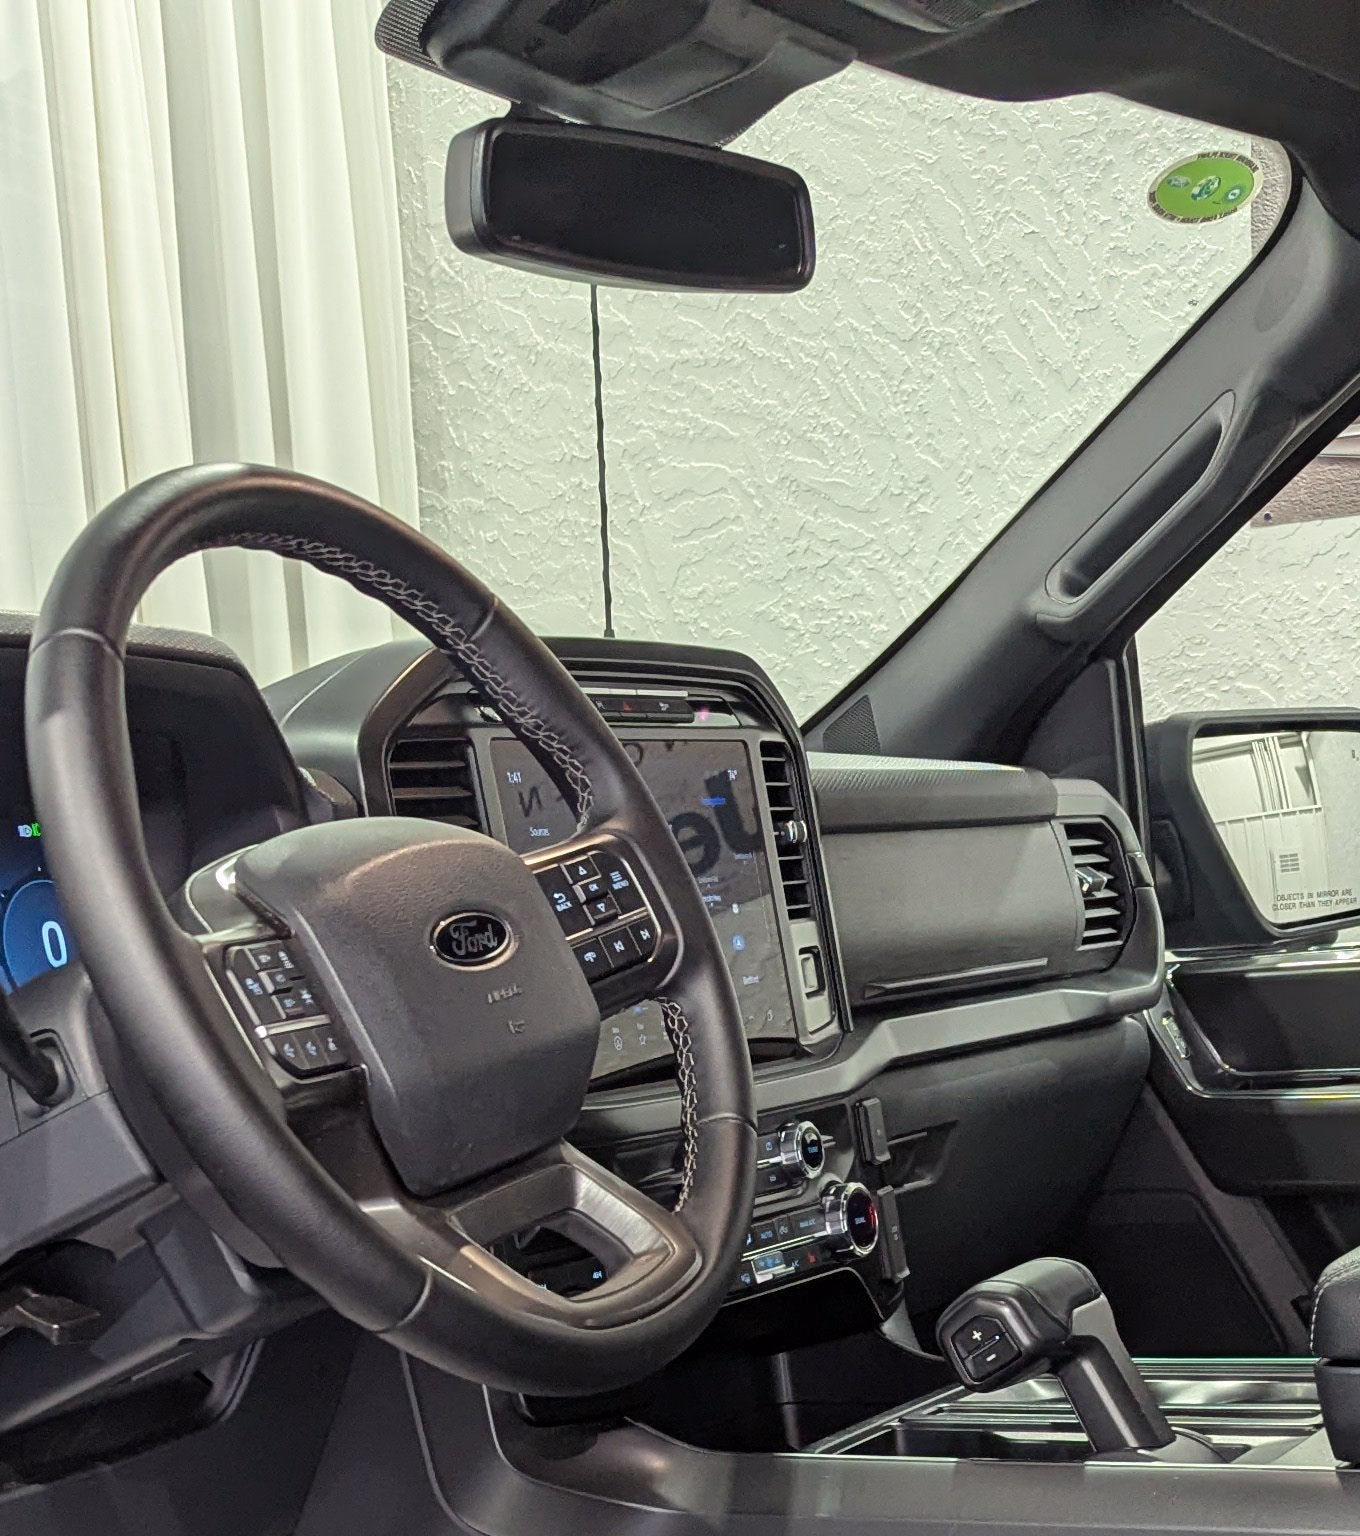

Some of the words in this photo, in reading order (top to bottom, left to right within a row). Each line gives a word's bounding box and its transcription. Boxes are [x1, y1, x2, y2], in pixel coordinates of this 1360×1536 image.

[1272, 902, 1297, 912] CLOSER
[1299, 901, 1316, 909] THAN
[1318, 899, 1333, 907] THEY
[1334, 897, 1358, 906] APPEAR
[1276, 892, 1305, 902] OBJECTS
[1316, 889, 1339, 898] MIRROR
[1341, 888, 1353, 896] ARE
[41, 920, 68, 968] 0
[449, 919, 498, 956] Ford
